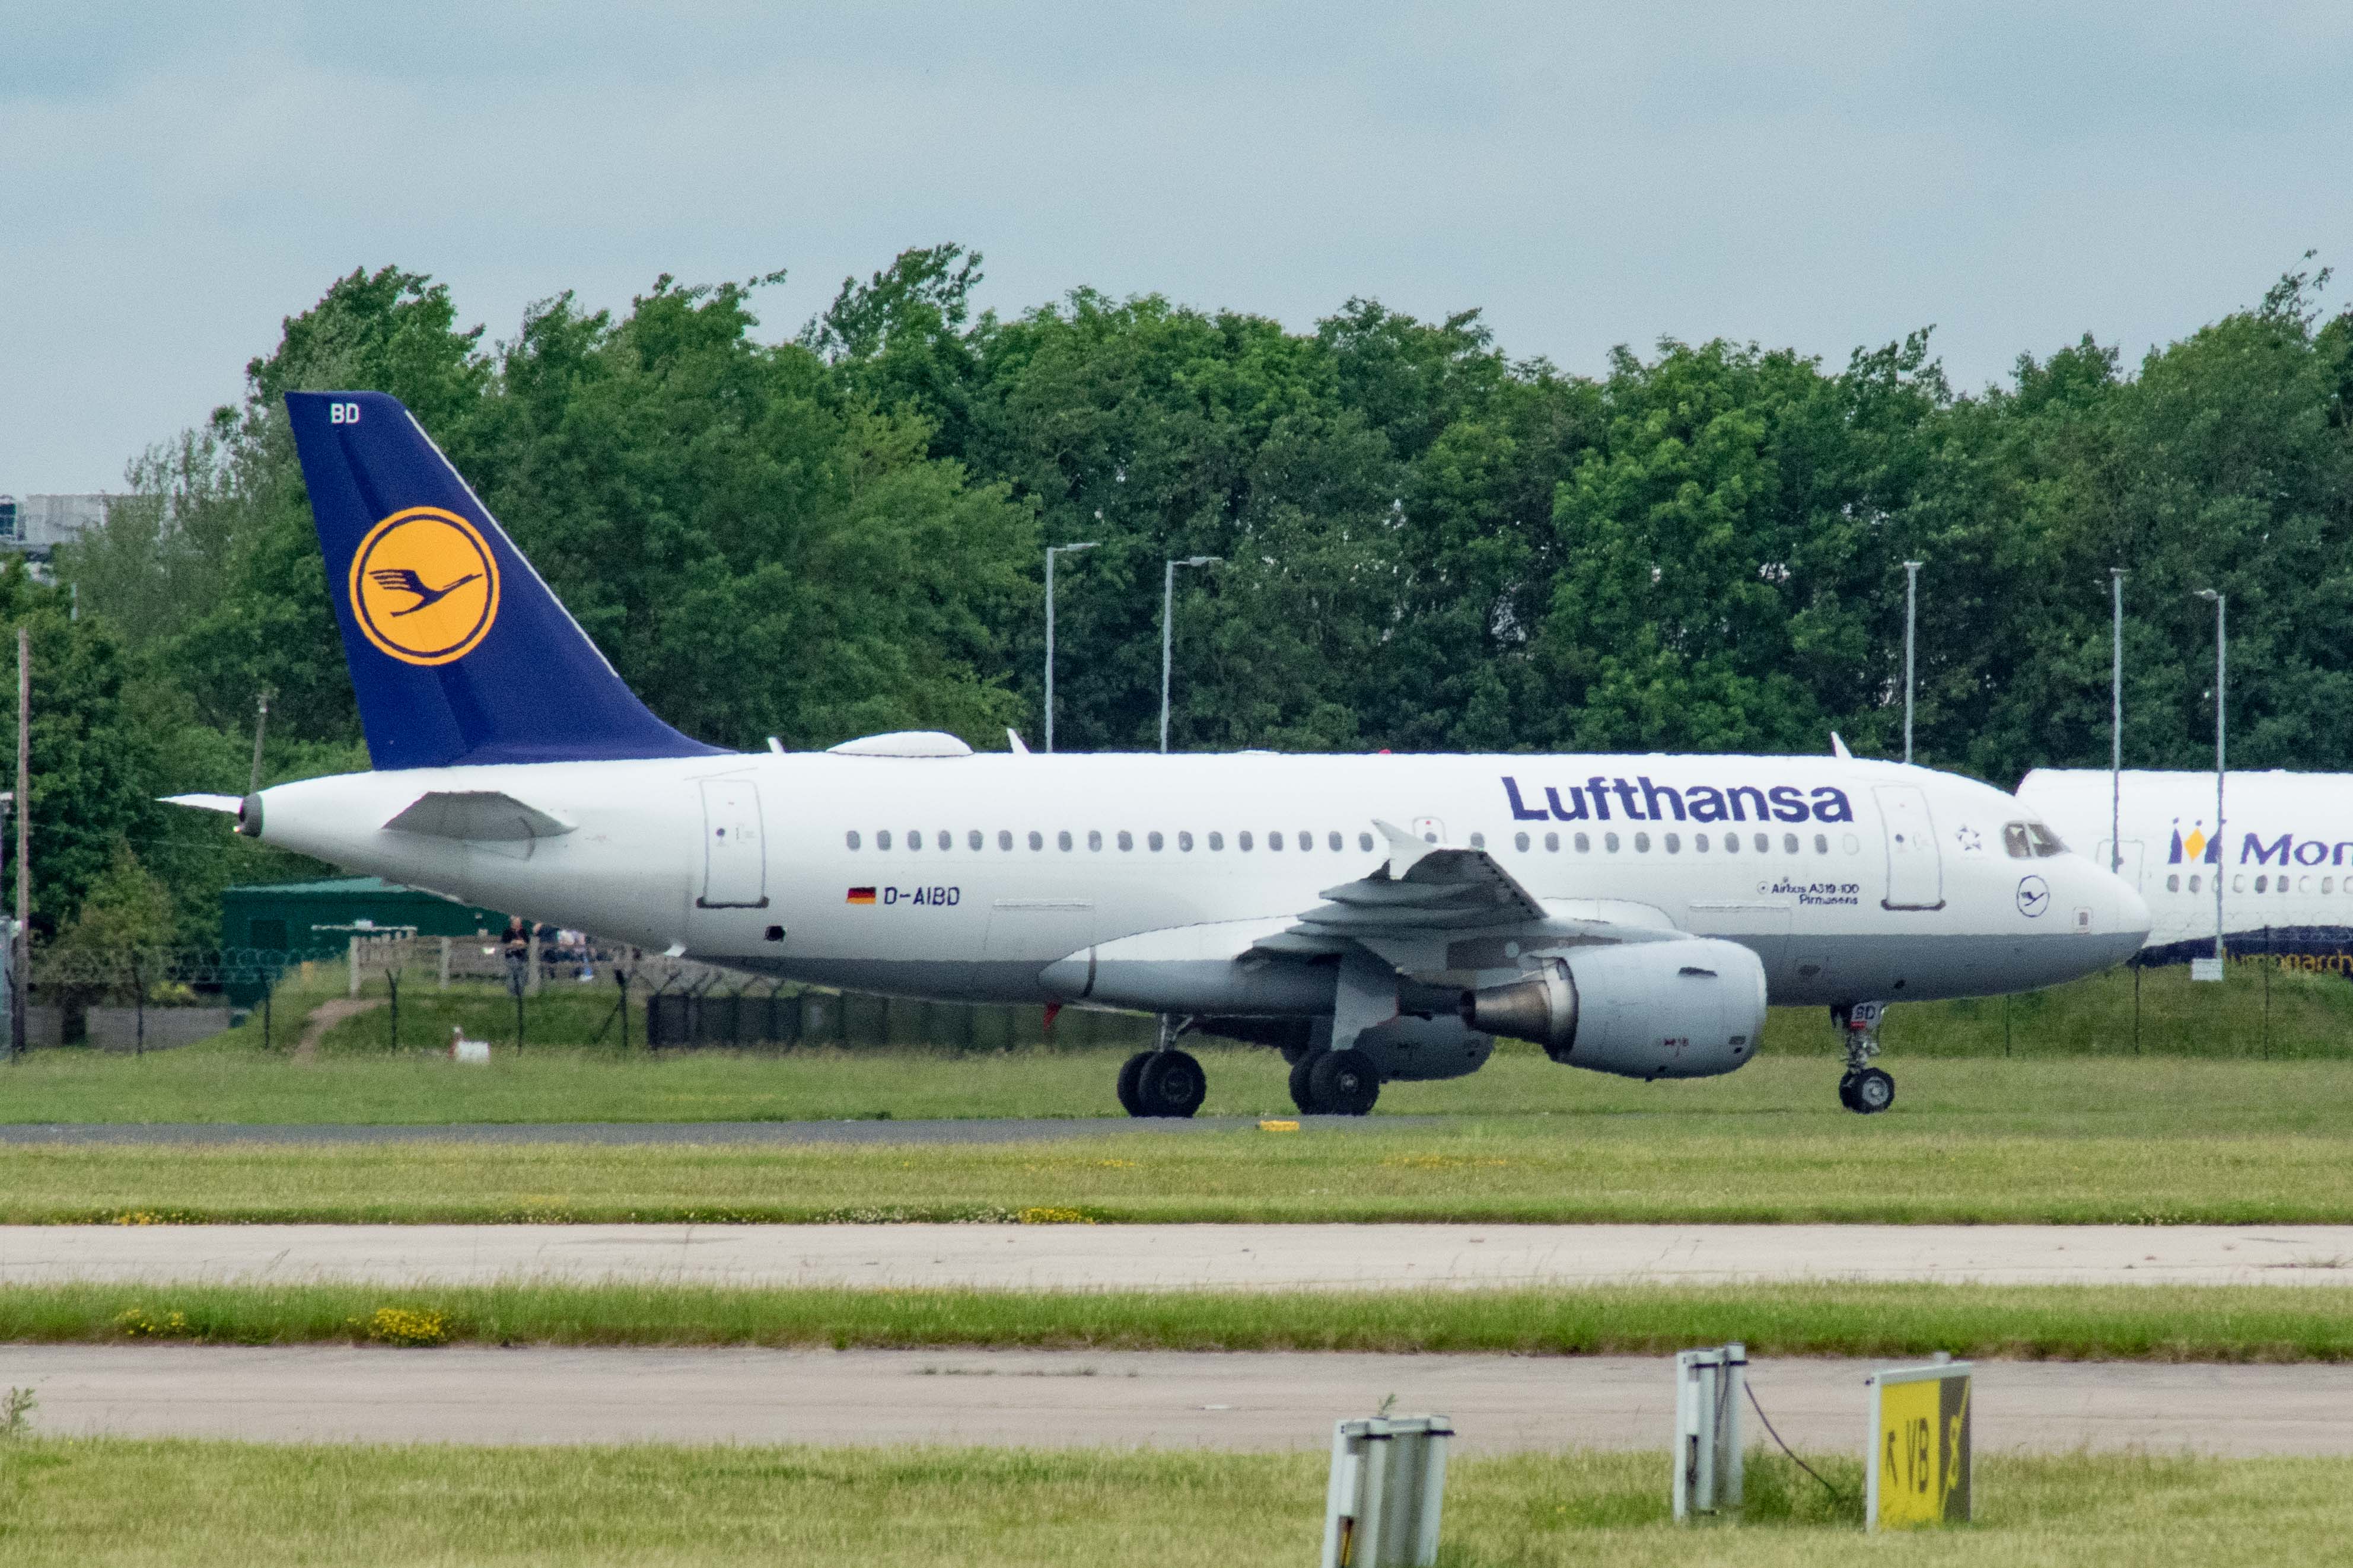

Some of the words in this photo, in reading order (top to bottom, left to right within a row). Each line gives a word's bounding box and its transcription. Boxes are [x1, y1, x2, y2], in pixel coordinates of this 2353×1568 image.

[330, 403, 359, 424] BD
[1501, 776, 1854, 823] Lufthansa
[884, 887, 960, 906] D-AIBD
[1771, 884, 1807, 894] Airbus
[1809, 884, 1860, 894] A319-100
[1906, 1418, 1928, 1493] VB
